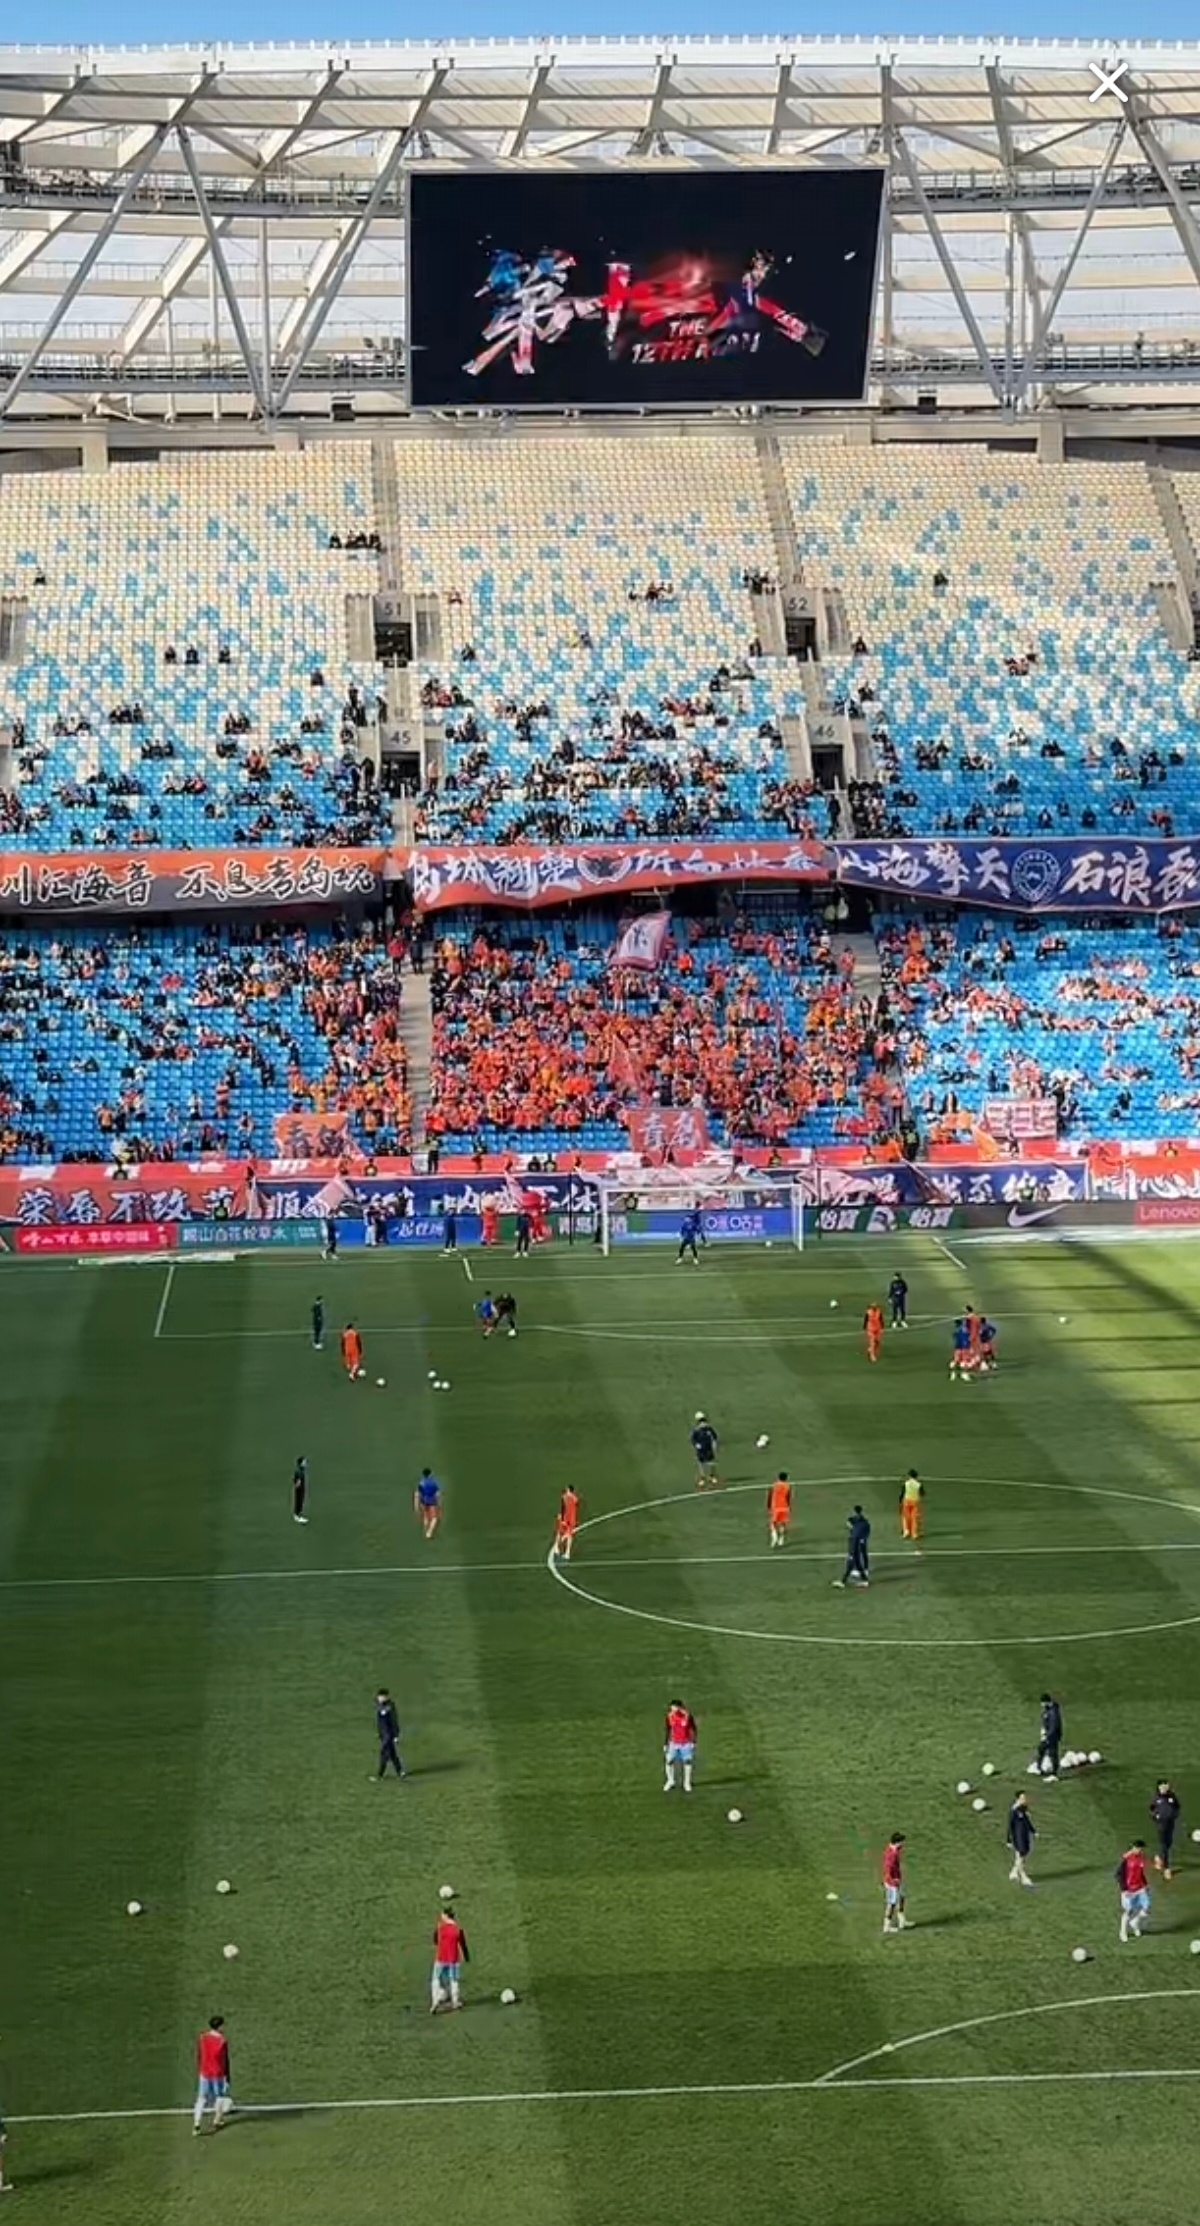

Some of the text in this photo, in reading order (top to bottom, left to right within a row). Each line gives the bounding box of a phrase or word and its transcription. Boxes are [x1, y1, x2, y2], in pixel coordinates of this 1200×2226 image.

[668, 319, 707, 337] THE
[384, 601, 402, 616] 51
[788, 597, 808, 611] 52
[390, 731, 411, 745] 45
[815, 724, 835, 738] 46
[1140, 1205, 1200, 1220] Lenovo
